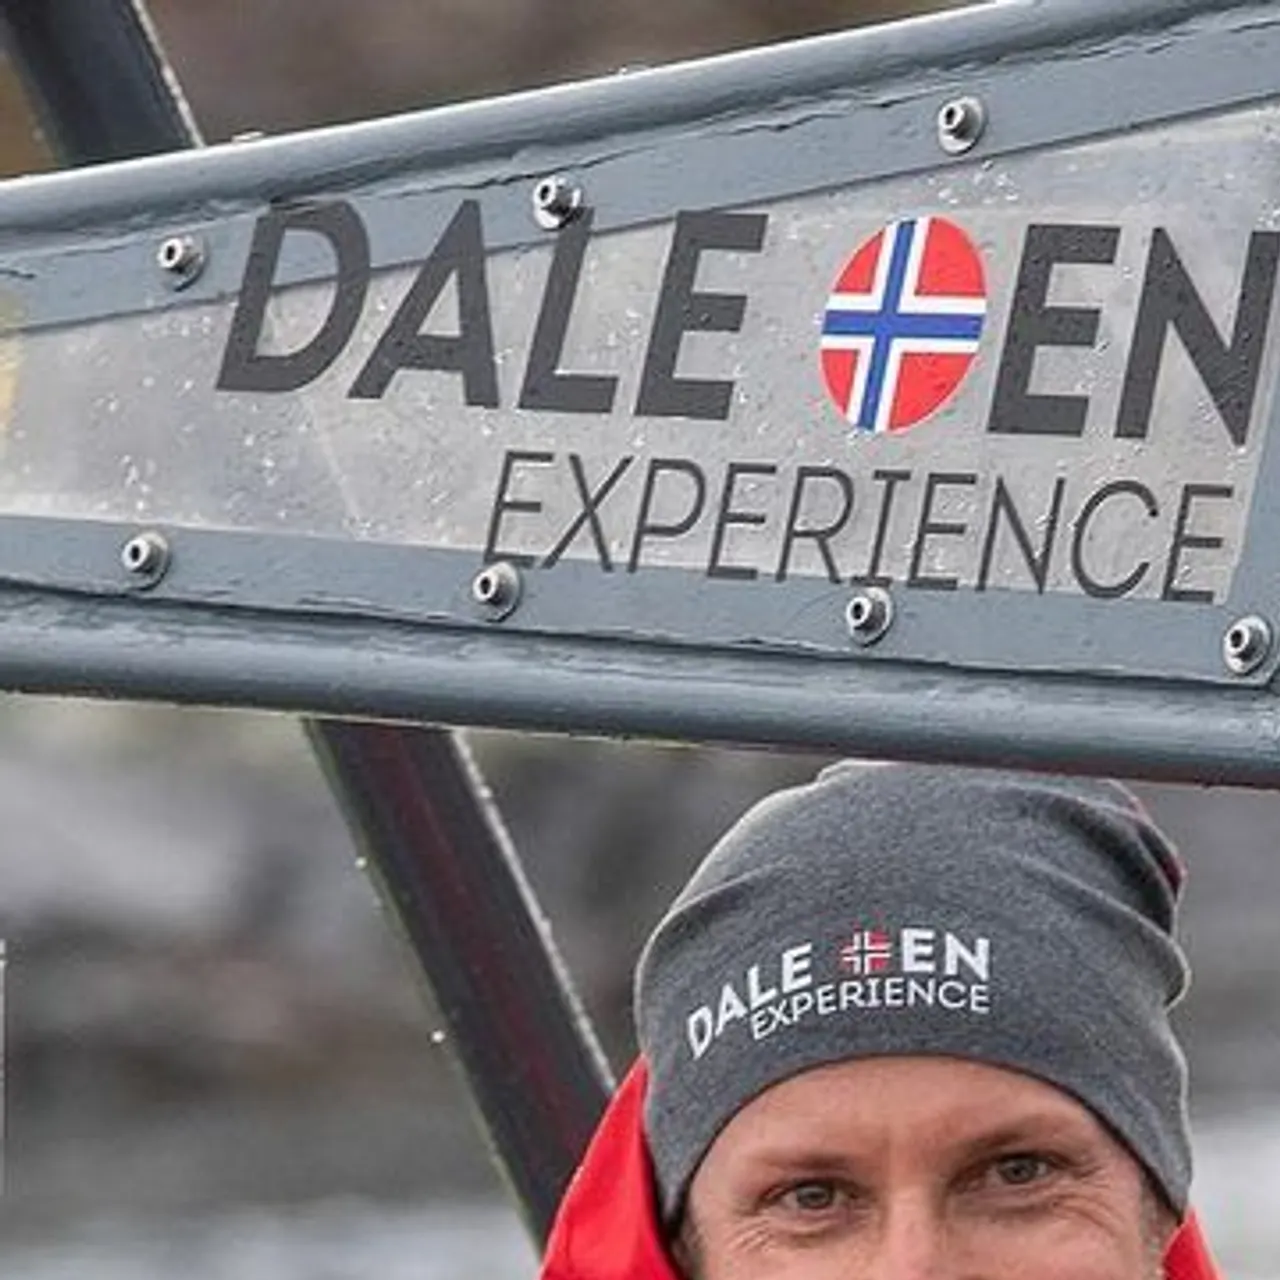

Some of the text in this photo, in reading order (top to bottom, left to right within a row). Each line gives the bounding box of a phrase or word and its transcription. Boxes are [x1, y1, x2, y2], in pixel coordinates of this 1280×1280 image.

[214, 198, 769, 420] DALE
[482, 450, 1234, 603] EXPERIENCE
[687, 943, 813, 1059] DALE
[751, 977, 990, 1039] EXPERIENCE
